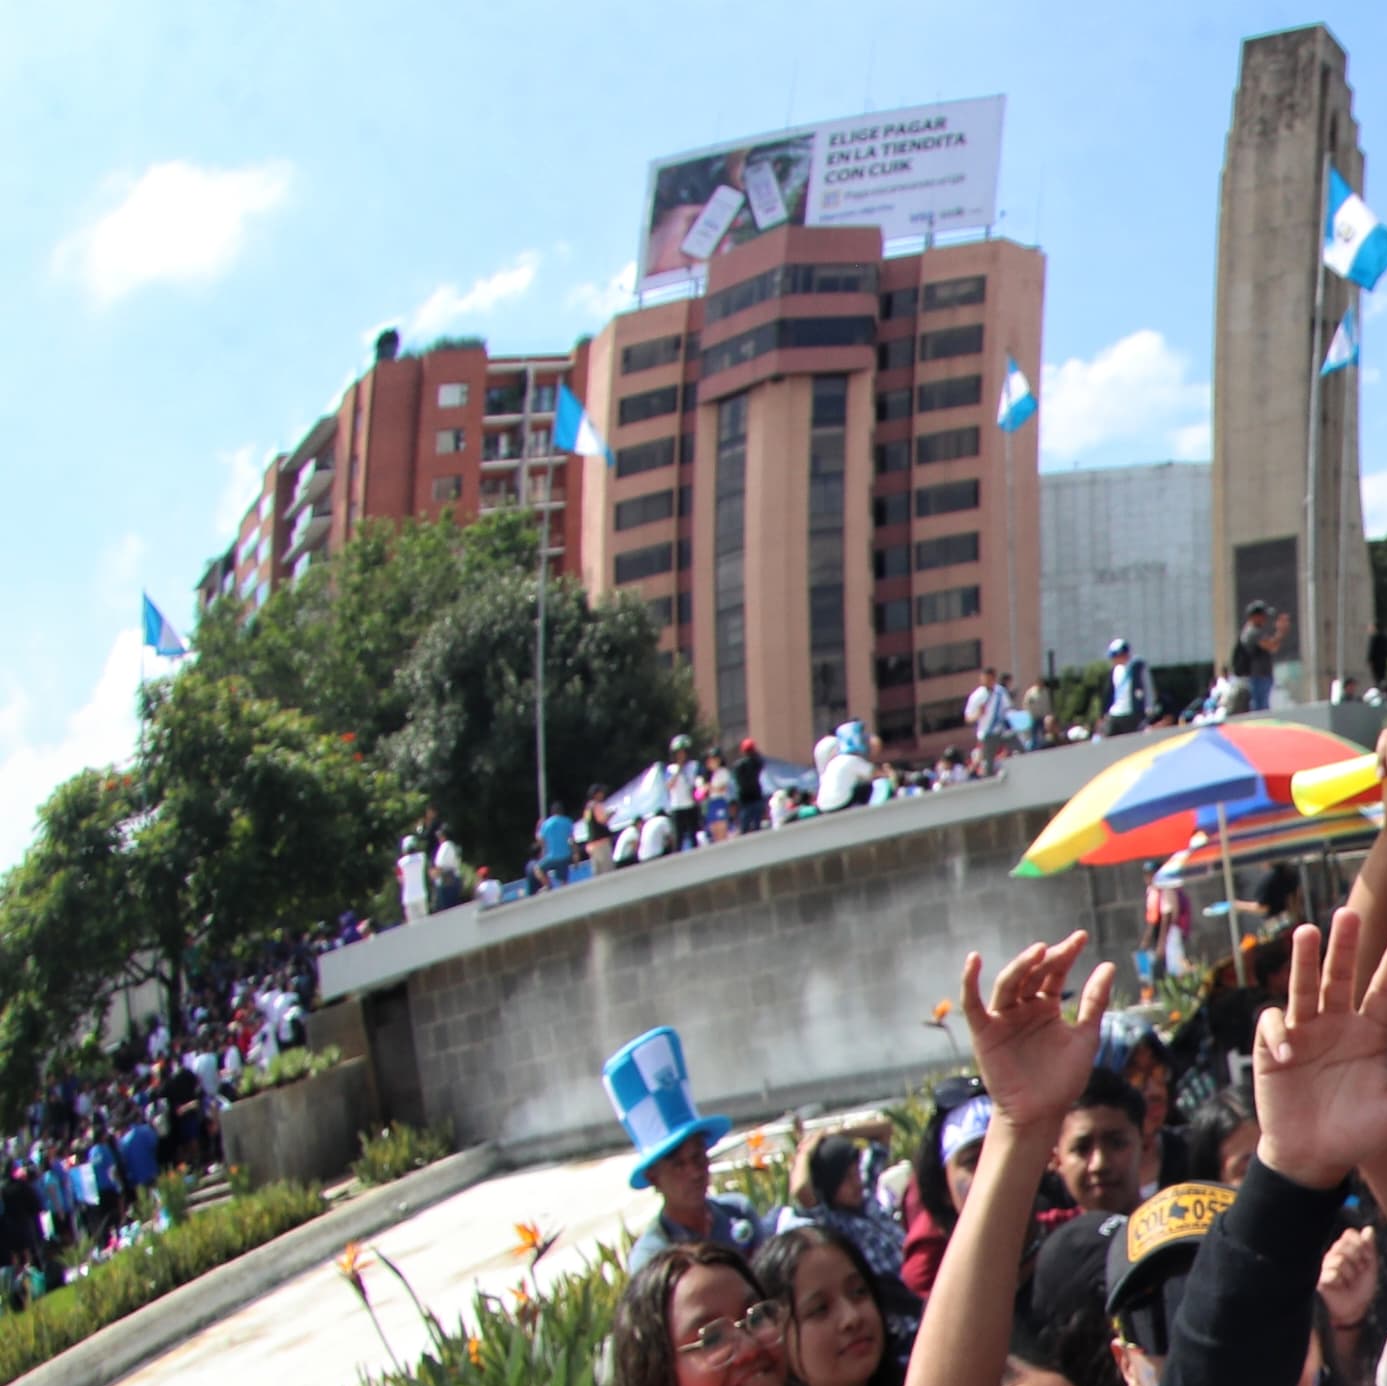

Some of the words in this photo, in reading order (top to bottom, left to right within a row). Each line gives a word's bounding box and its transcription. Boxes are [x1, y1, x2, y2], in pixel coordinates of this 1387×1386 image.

[828, 126, 878, 147] ELIGE
[883, 116, 948, 137] PAGAR
[826, 150, 850, 166] EN
[853, 145, 876, 161] LA
[883, 132, 967, 156] TIENDITA
[824, 166, 864, 184] CON
